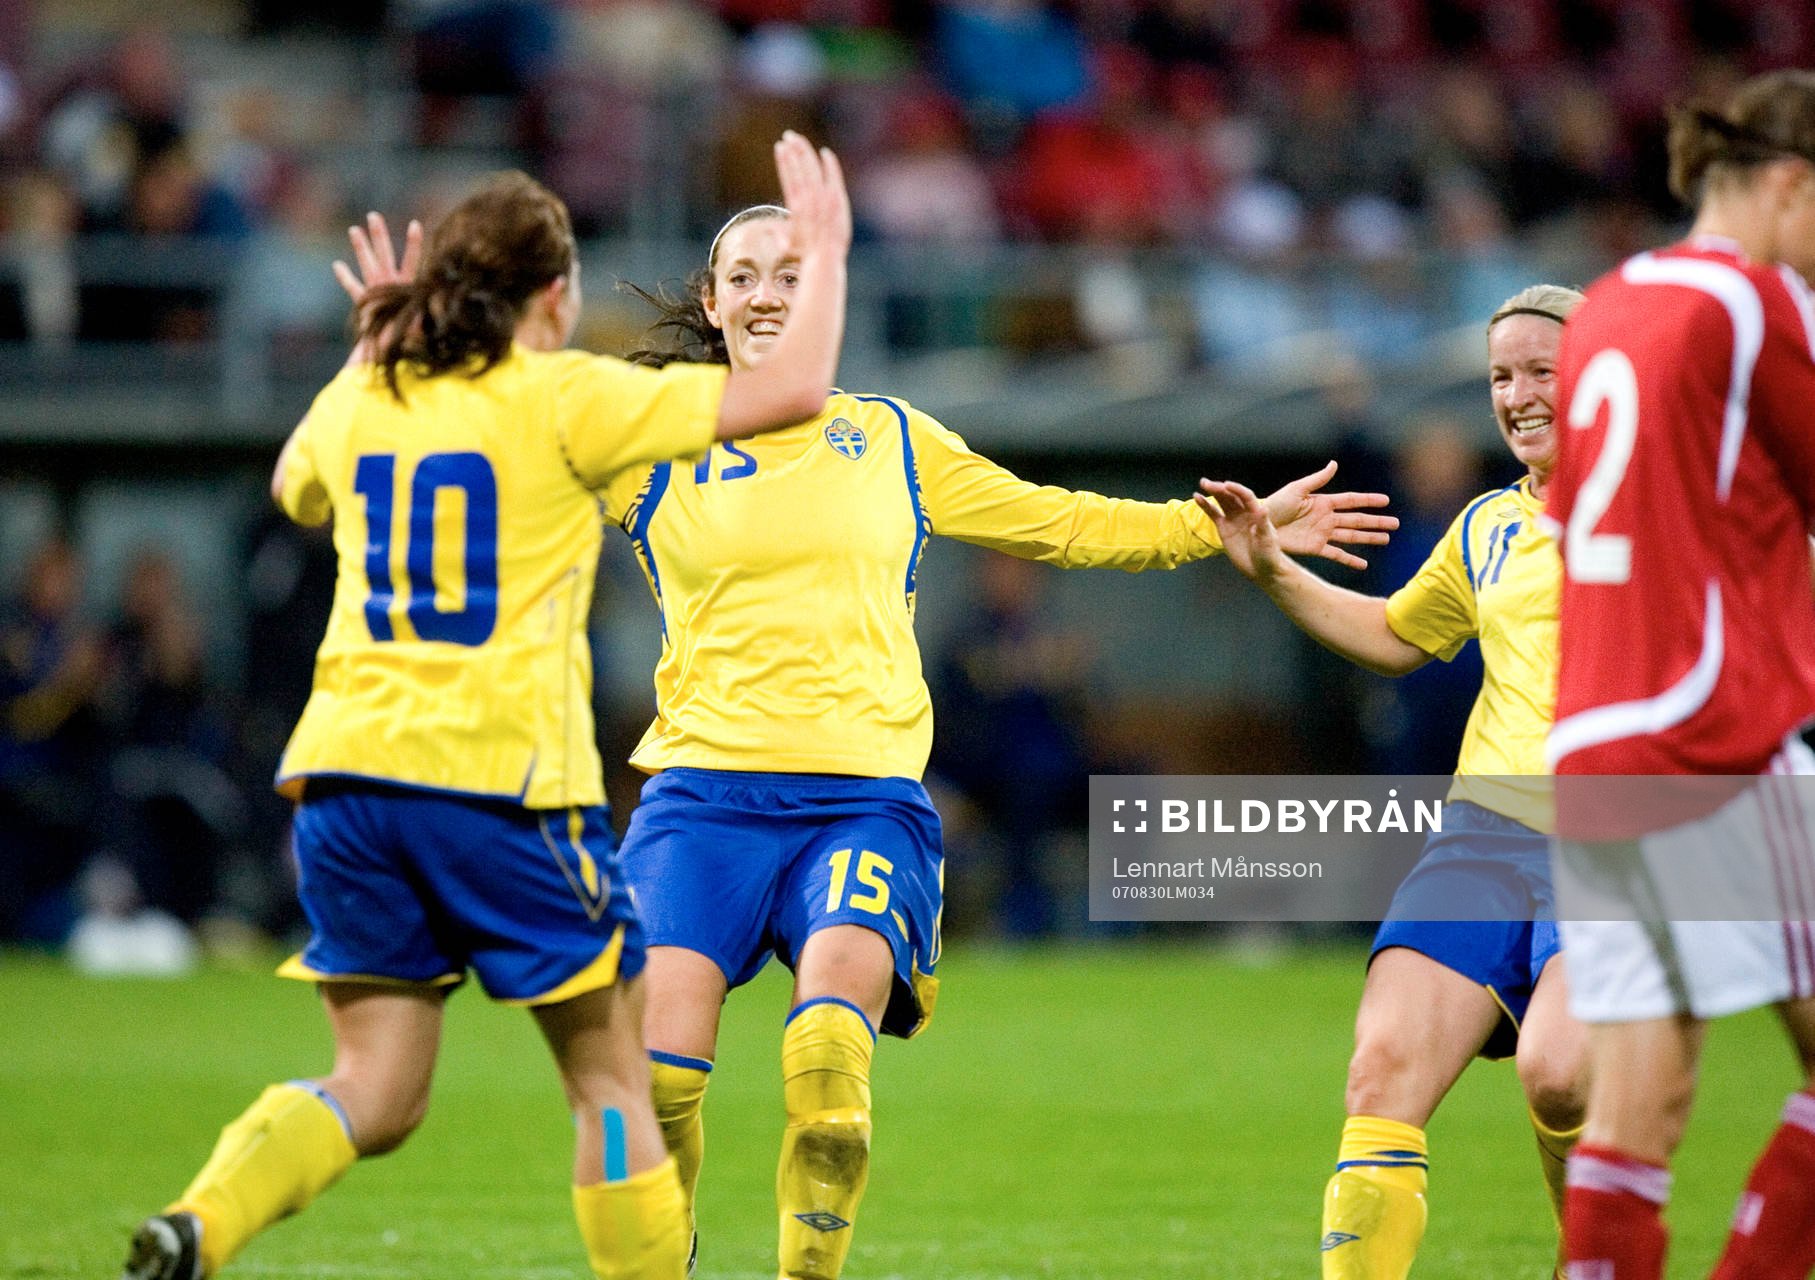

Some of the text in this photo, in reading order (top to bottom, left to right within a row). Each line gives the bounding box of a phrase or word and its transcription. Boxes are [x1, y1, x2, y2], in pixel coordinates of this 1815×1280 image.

[354, 452, 498, 646] 10
[1567, 348, 1639, 583] 2
[826, 849, 893, 915] 15
